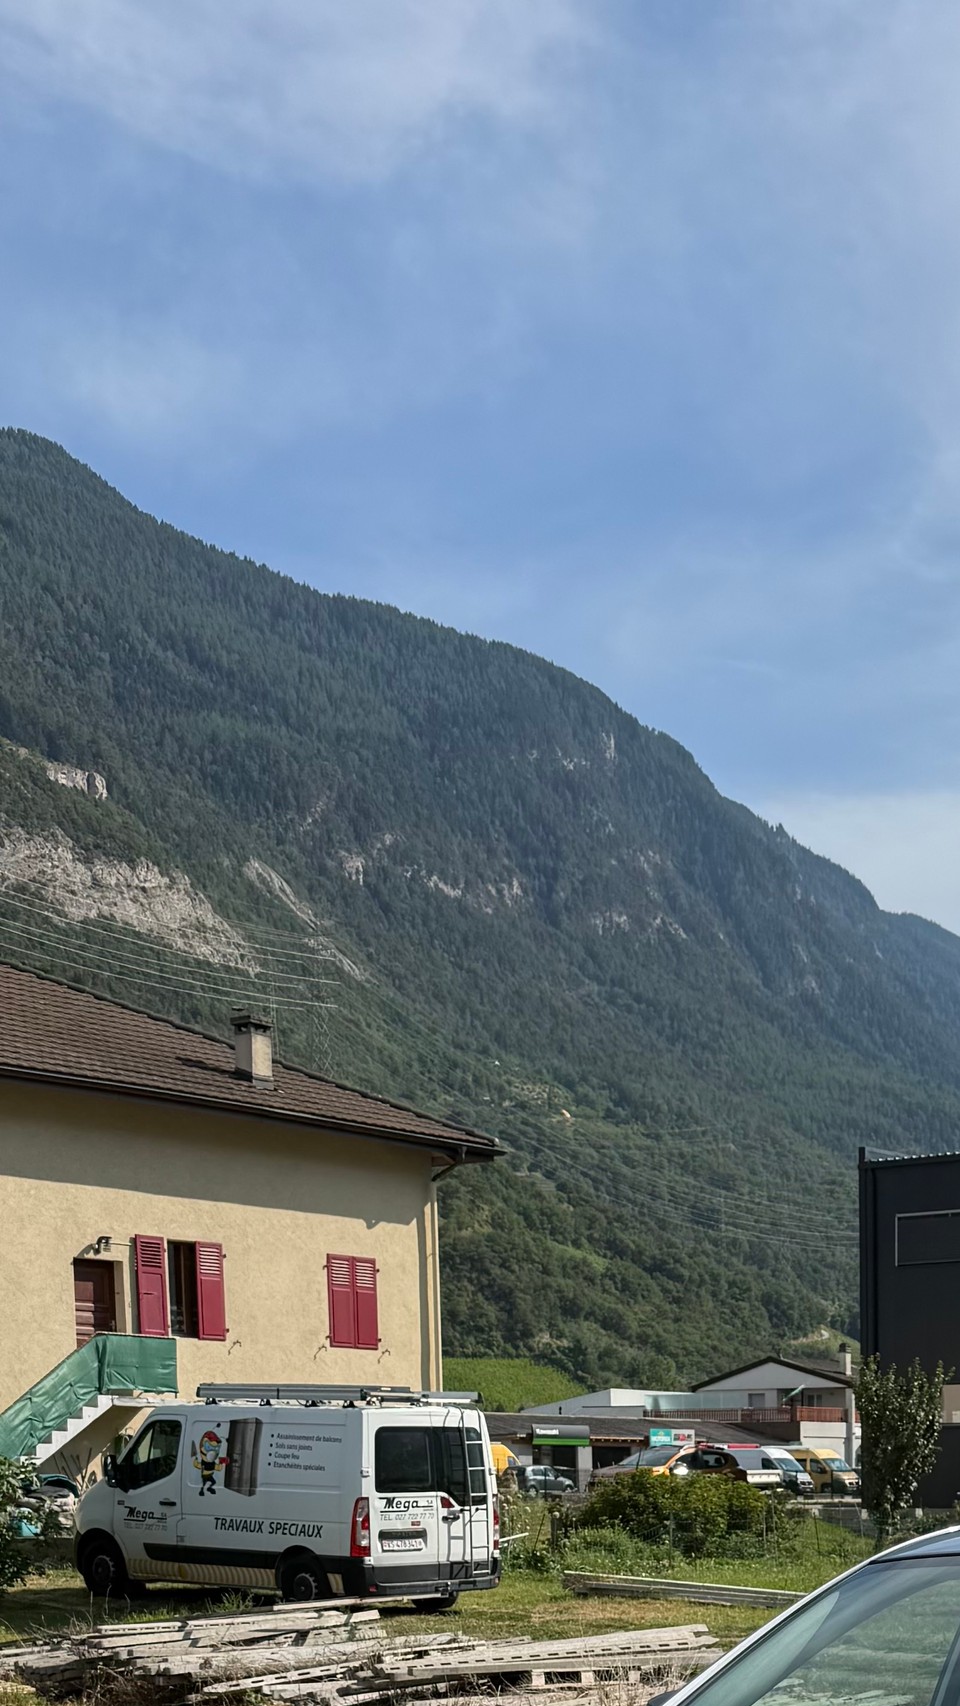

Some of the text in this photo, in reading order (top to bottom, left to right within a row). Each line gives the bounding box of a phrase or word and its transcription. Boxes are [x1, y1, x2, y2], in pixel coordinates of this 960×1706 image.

[378, 1497, 419, 1513] Mega
[124, 1506, 154, 1522] Mega
[214, 1517, 324, 1539] TRAVAUX SPECIAUX
